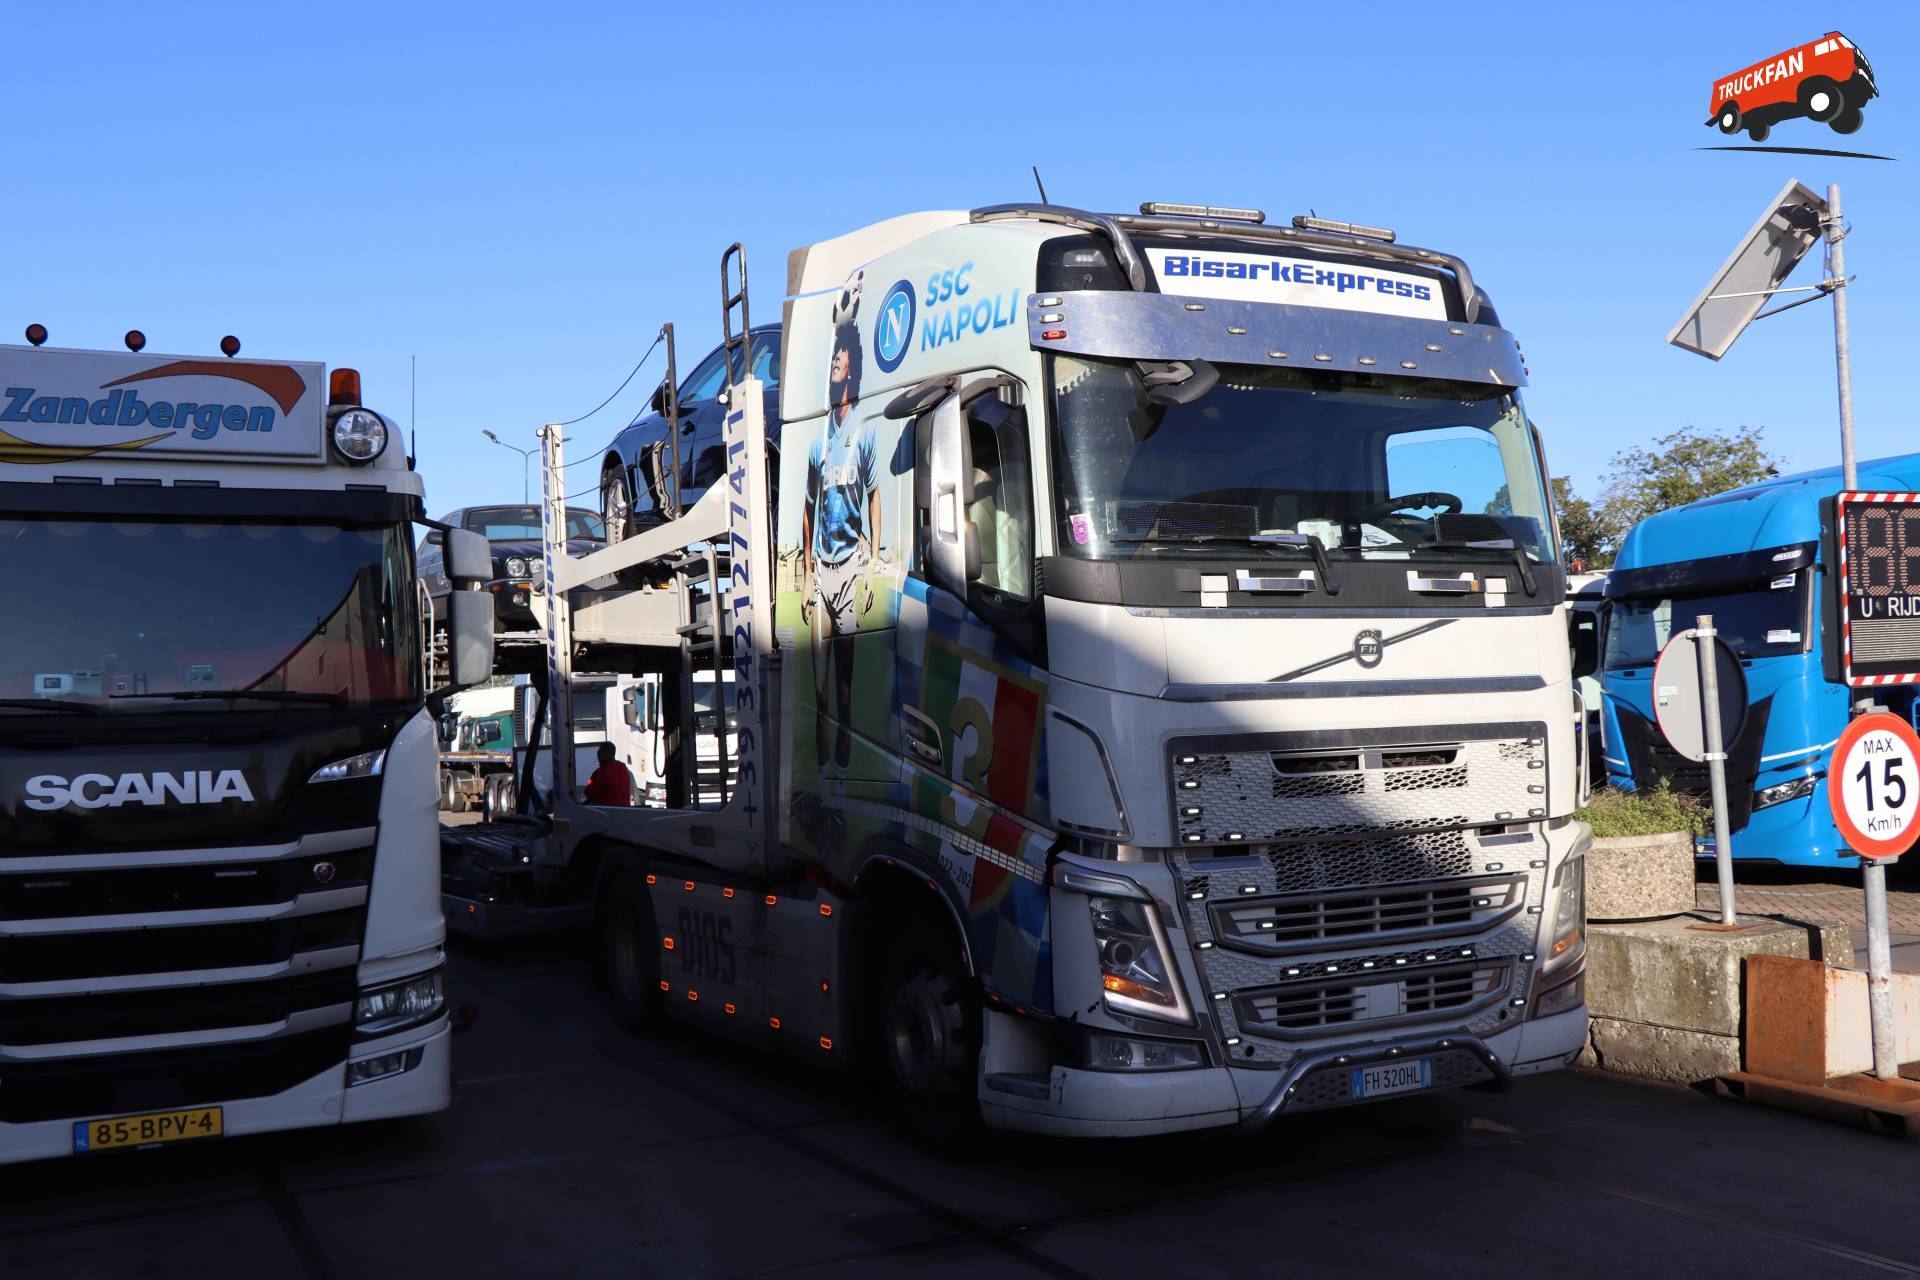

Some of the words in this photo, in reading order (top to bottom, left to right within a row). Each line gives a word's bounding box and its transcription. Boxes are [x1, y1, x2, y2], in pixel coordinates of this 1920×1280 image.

[925, 261, 975, 307] SSC
[1164, 256, 1431, 302] BisarkExpress
[921, 288, 1020, 352] NAPOLI
[0, 389, 276, 440] Zandbergen
[726, 408, 755, 712] 3421277411
[1861, 597, 1873, 618] U
[1361, 645, 1377, 653] FH
[1864, 737, 1893, 755] MAX
[24, 769, 254, 811] SCANIA
[737, 729, 757, 829] +39
[1856, 757, 1906, 811] 15
[1868, 814, 1902, 832] Km/h
[1364, 1071, 1380, 1092] FH
[1383, 1066, 1419, 1089] 320HL
[96, 1113, 214, 1145] 85-BPV-4
